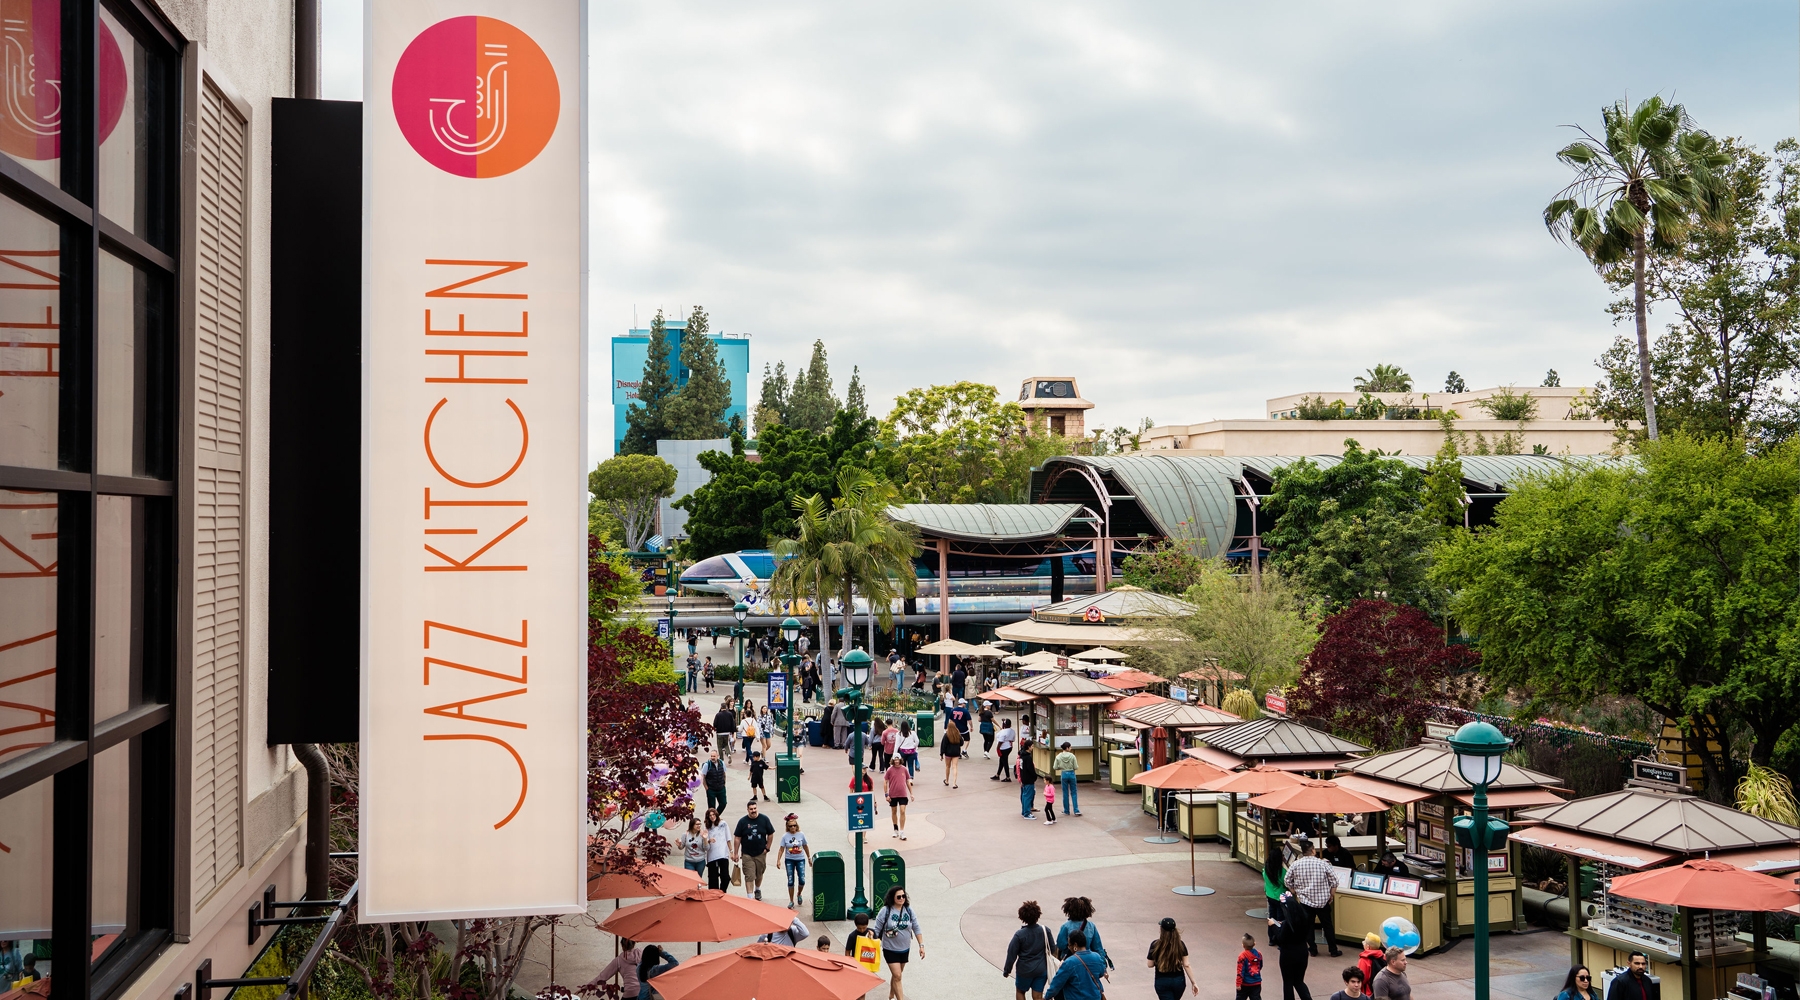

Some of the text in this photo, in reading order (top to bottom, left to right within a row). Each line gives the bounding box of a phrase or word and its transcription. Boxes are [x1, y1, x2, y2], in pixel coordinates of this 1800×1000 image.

[424, 259, 529, 829] JAZZ KITCHEN
[953, 711, 963, 720] 77
